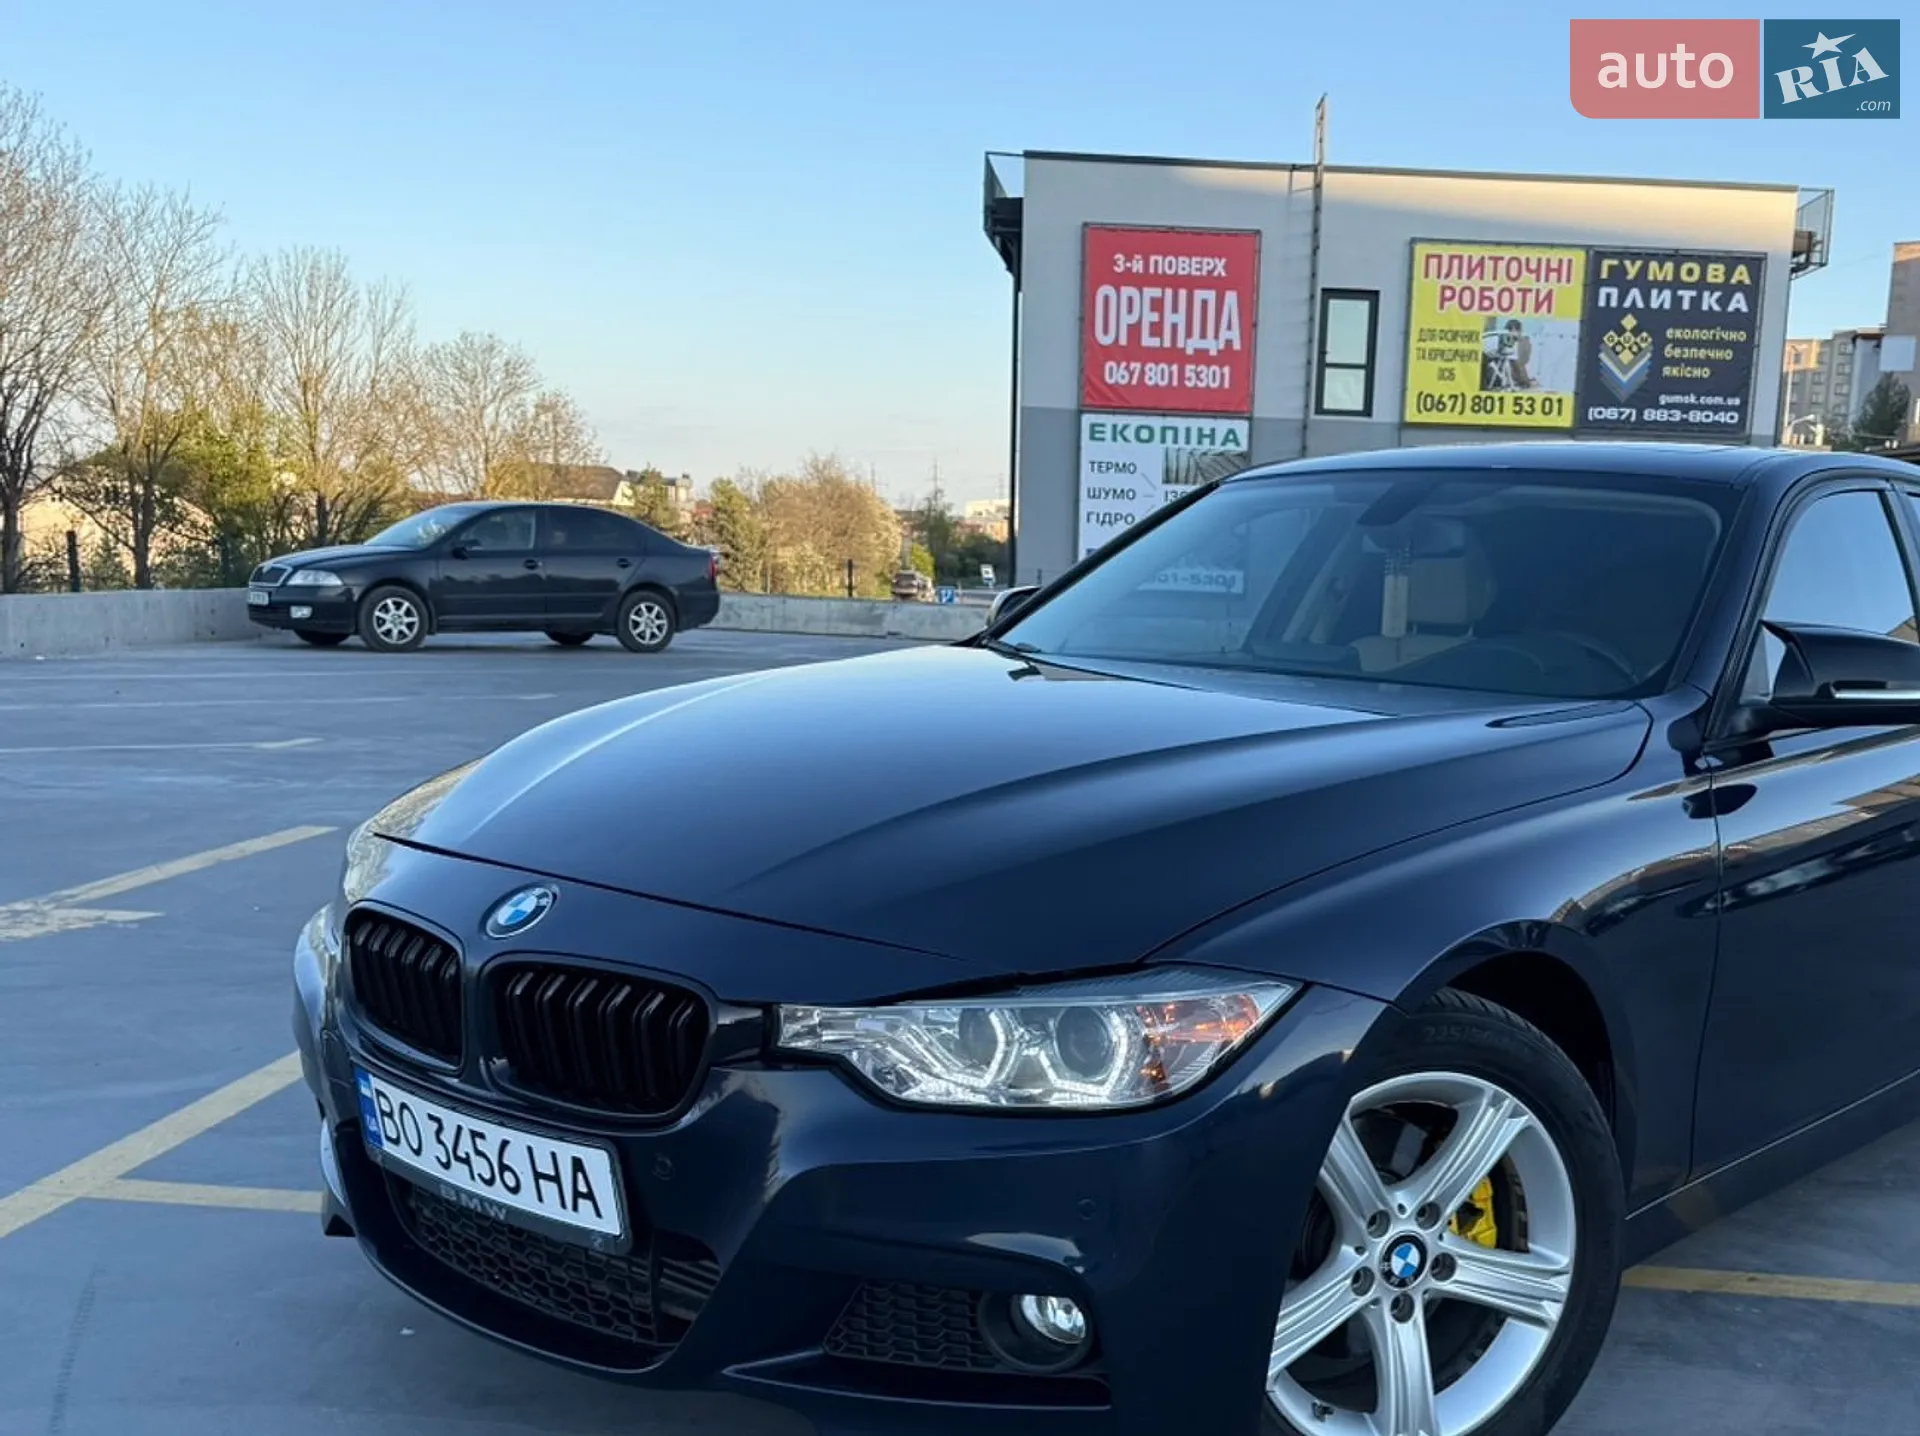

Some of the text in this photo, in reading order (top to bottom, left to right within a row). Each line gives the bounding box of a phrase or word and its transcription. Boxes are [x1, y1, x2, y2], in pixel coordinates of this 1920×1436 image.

[1113, 254, 1228, 277] 3-й ПОВЕРХ
[1424, 254, 1573, 284] ПЛИТОЧНІ
[1599, 258, 1752, 285] ГУМОВА
[1438, 285, 1555, 314] РОБОТИ
[1597, 286, 1749, 313] ПЛИТКА
[1094, 284, 1241, 356] ОРЕНДА
[1666, 326, 1747, 342] екологічно
[1664, 343, 1733, 361] безпечно
[1185, 365, 1231, 389] 5301
[1662, 363, 1711, 379] якісно
[1416, 391, 1563, 416] (067) 801 53 01
[1088, 422, 1241, 447] ЕКОПІНА
[1089, 461, 1137, 475] ТЕРМО
[1087, 487, 1136, 501] ШУМО
[1086, 511, 1136, 527] ГІДРО
[375, 1088, 603, 1219] BO 3456 HA
[439, 1184, 507, 1221] BMW
